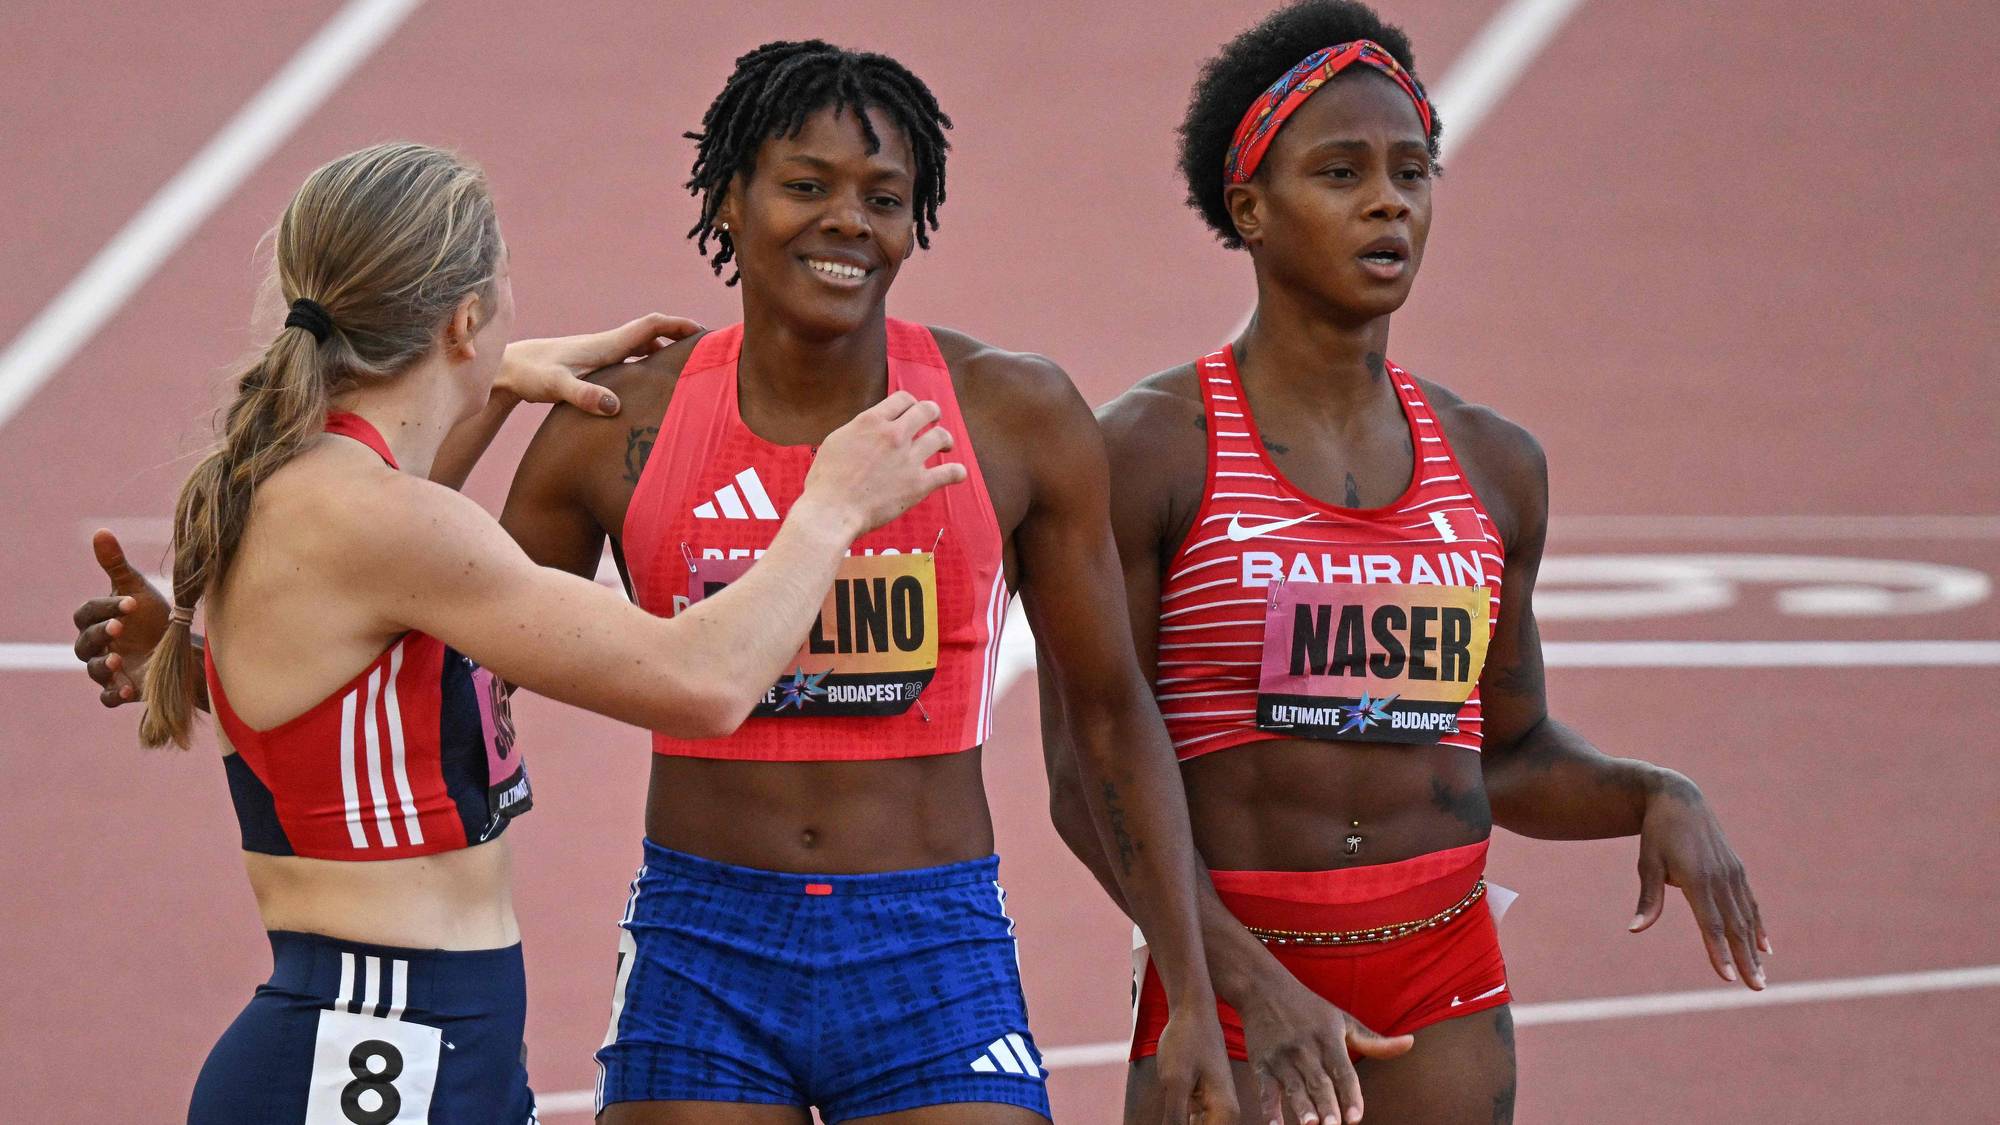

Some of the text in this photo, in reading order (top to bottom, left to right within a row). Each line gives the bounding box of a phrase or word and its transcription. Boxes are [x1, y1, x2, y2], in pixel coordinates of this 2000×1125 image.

[1242, 550, 1485, 587] BAHRAIN
[1290, 603, 1472, 682] NASER
[827, 683, 903, 702] BUDAPEST
[1272, 705, 1340, 726] ULTIMATE
[340, 1039, 404, 1125] 8
